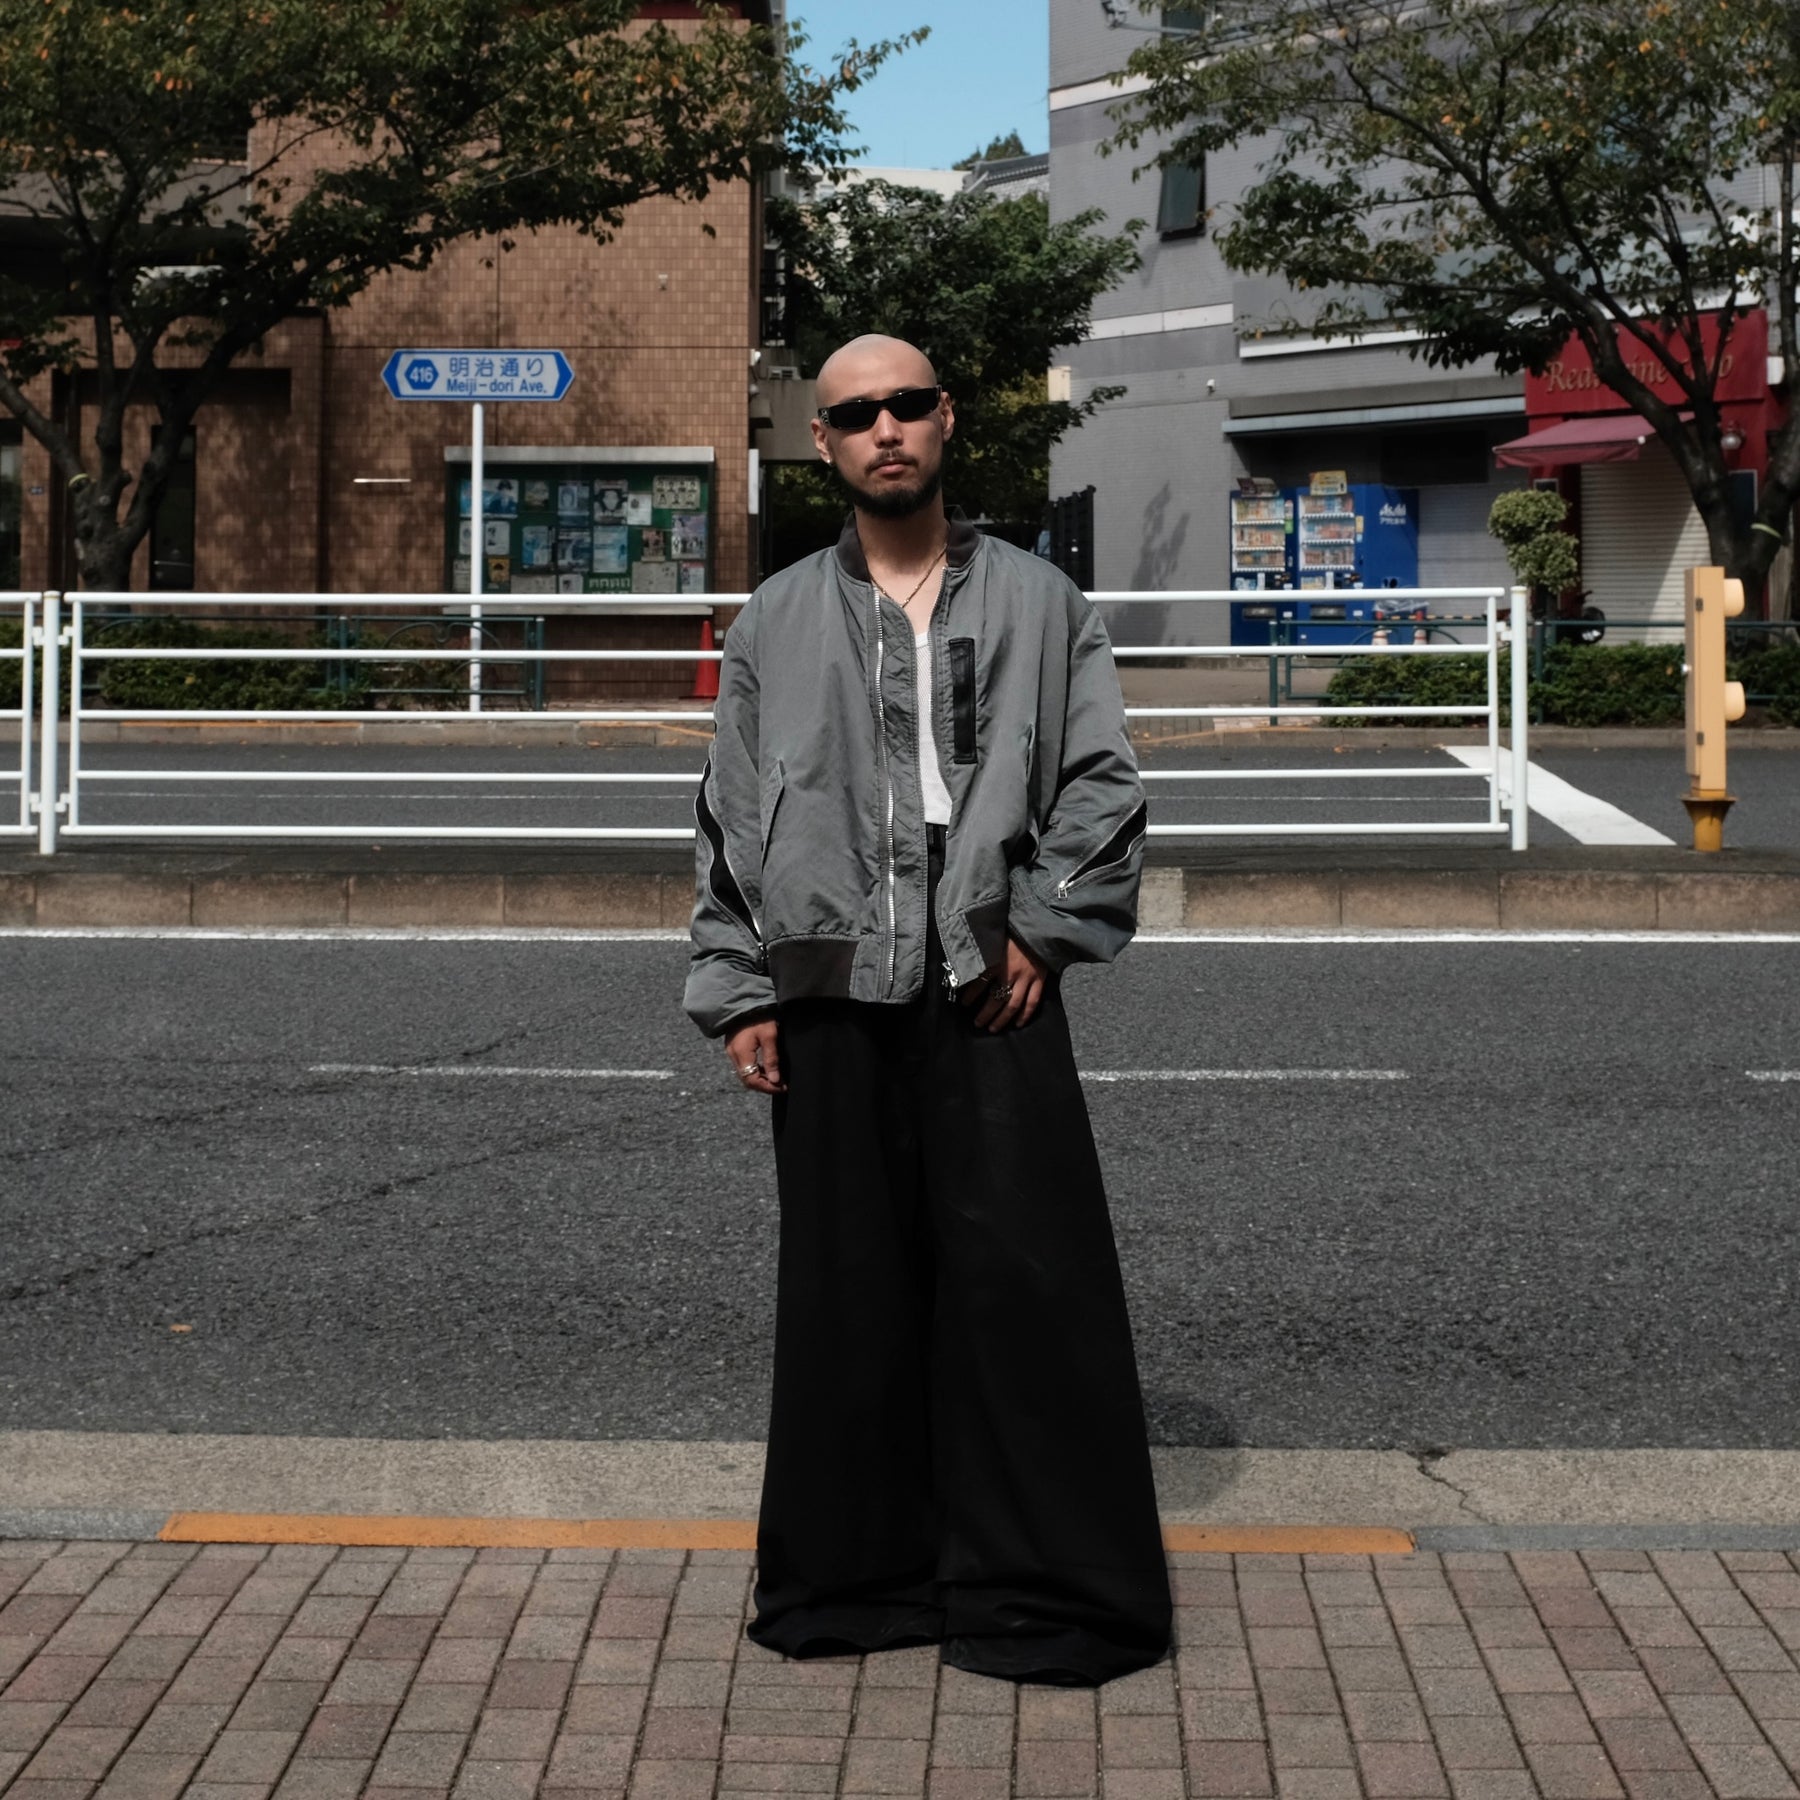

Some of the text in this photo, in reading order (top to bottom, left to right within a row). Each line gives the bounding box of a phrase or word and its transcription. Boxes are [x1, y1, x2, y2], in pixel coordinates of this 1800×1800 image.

[409, 366, 434, 384] 416
[449, 357, 545, 378] 明治通り
[446, 379, 547, 396] Meiji-dori Ave.
